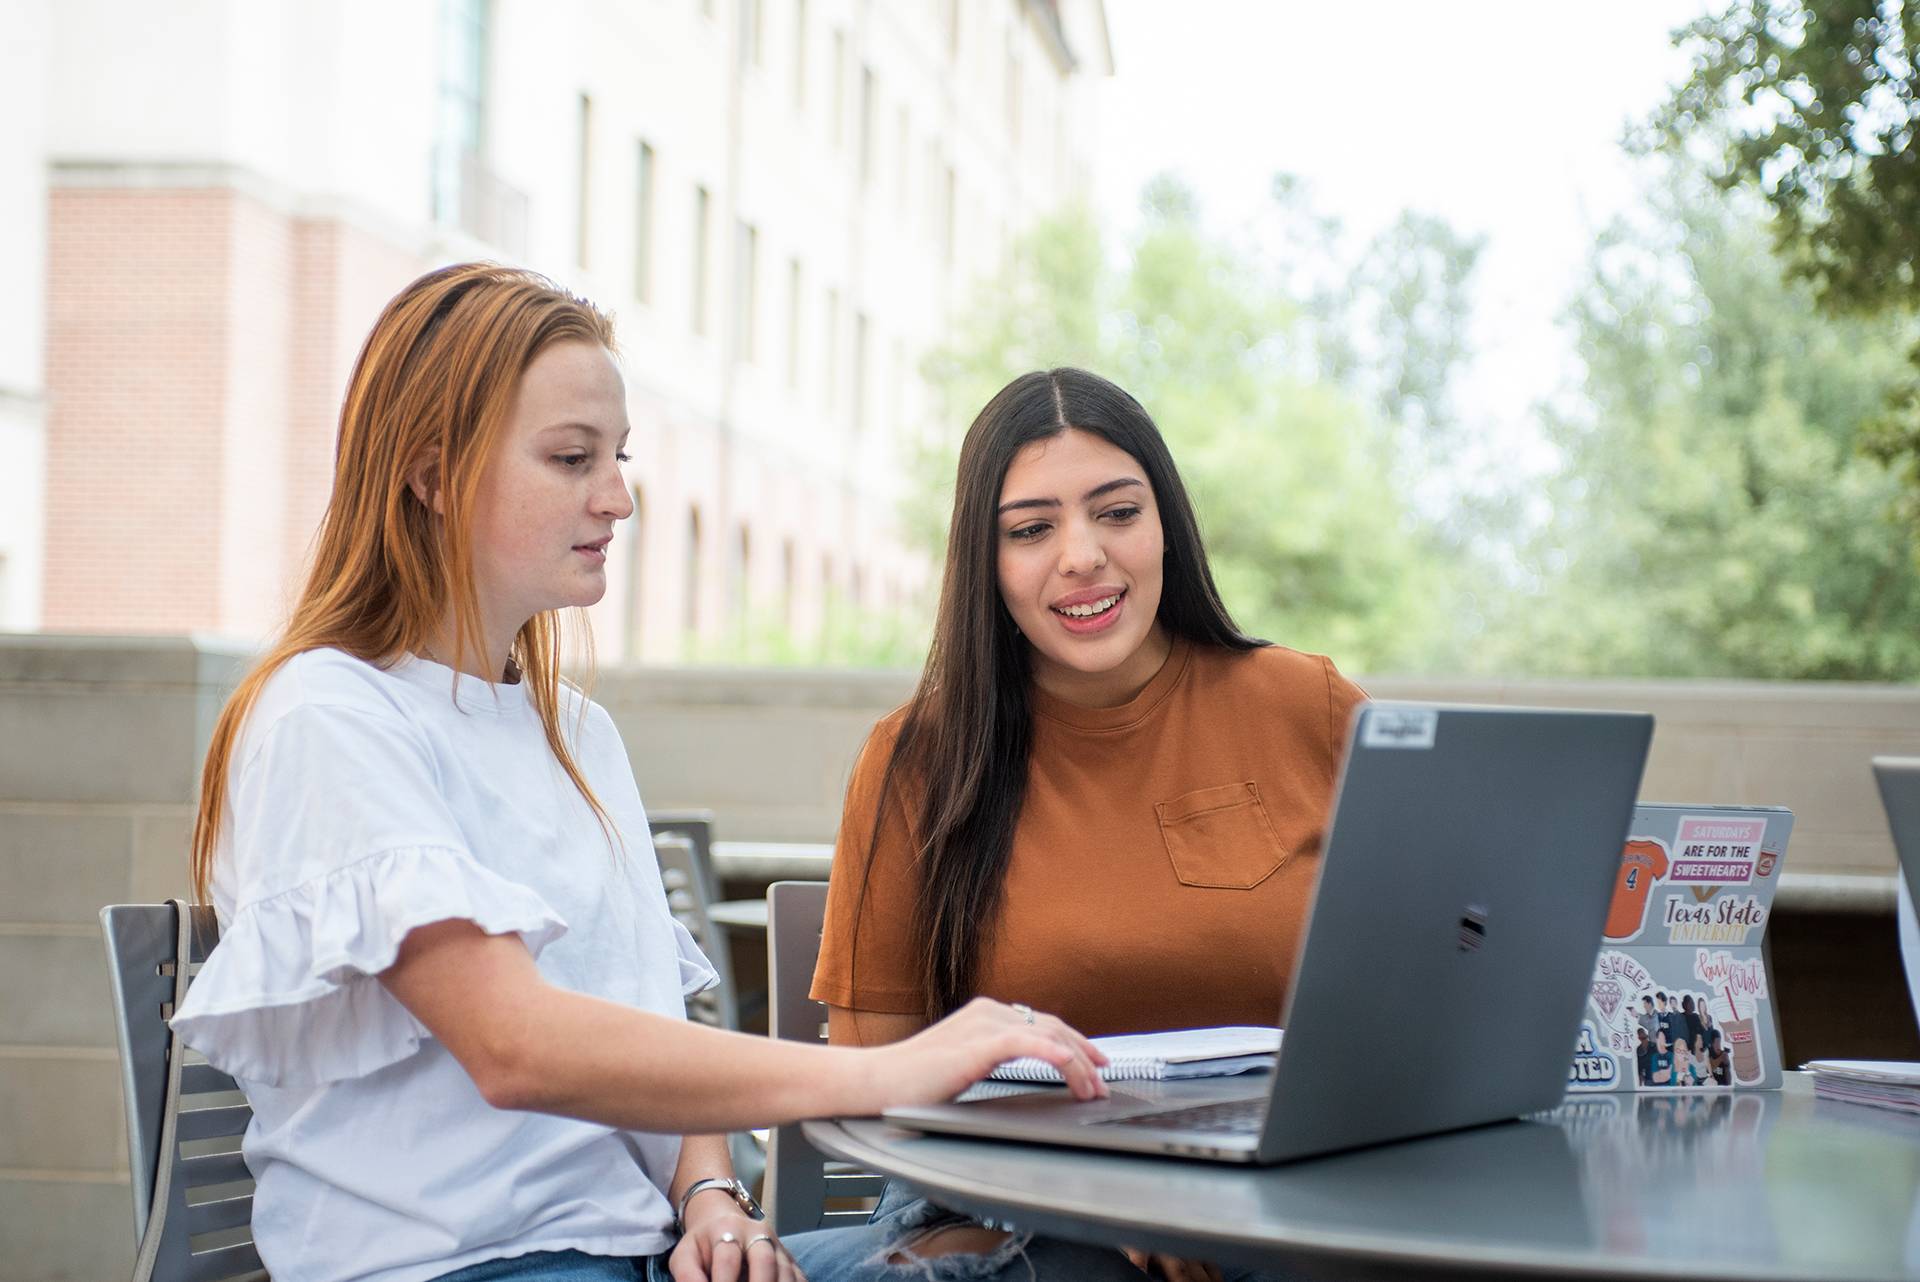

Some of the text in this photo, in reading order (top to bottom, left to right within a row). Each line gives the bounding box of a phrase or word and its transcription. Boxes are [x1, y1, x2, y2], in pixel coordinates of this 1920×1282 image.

[1692, 825, 1751, 838] SATURDAYS
[1683, 845, 1751, 858] ARE FOR THE
[1626, 867, 1638, 889] 4
[1674, 864, 1748, 877] SWEETHEARTS
[1667, 899, 1761, 925] Texas State
[1672, 923, 1745, 941] UNIVERSITY
[1698, 952, 1729, 982] but
